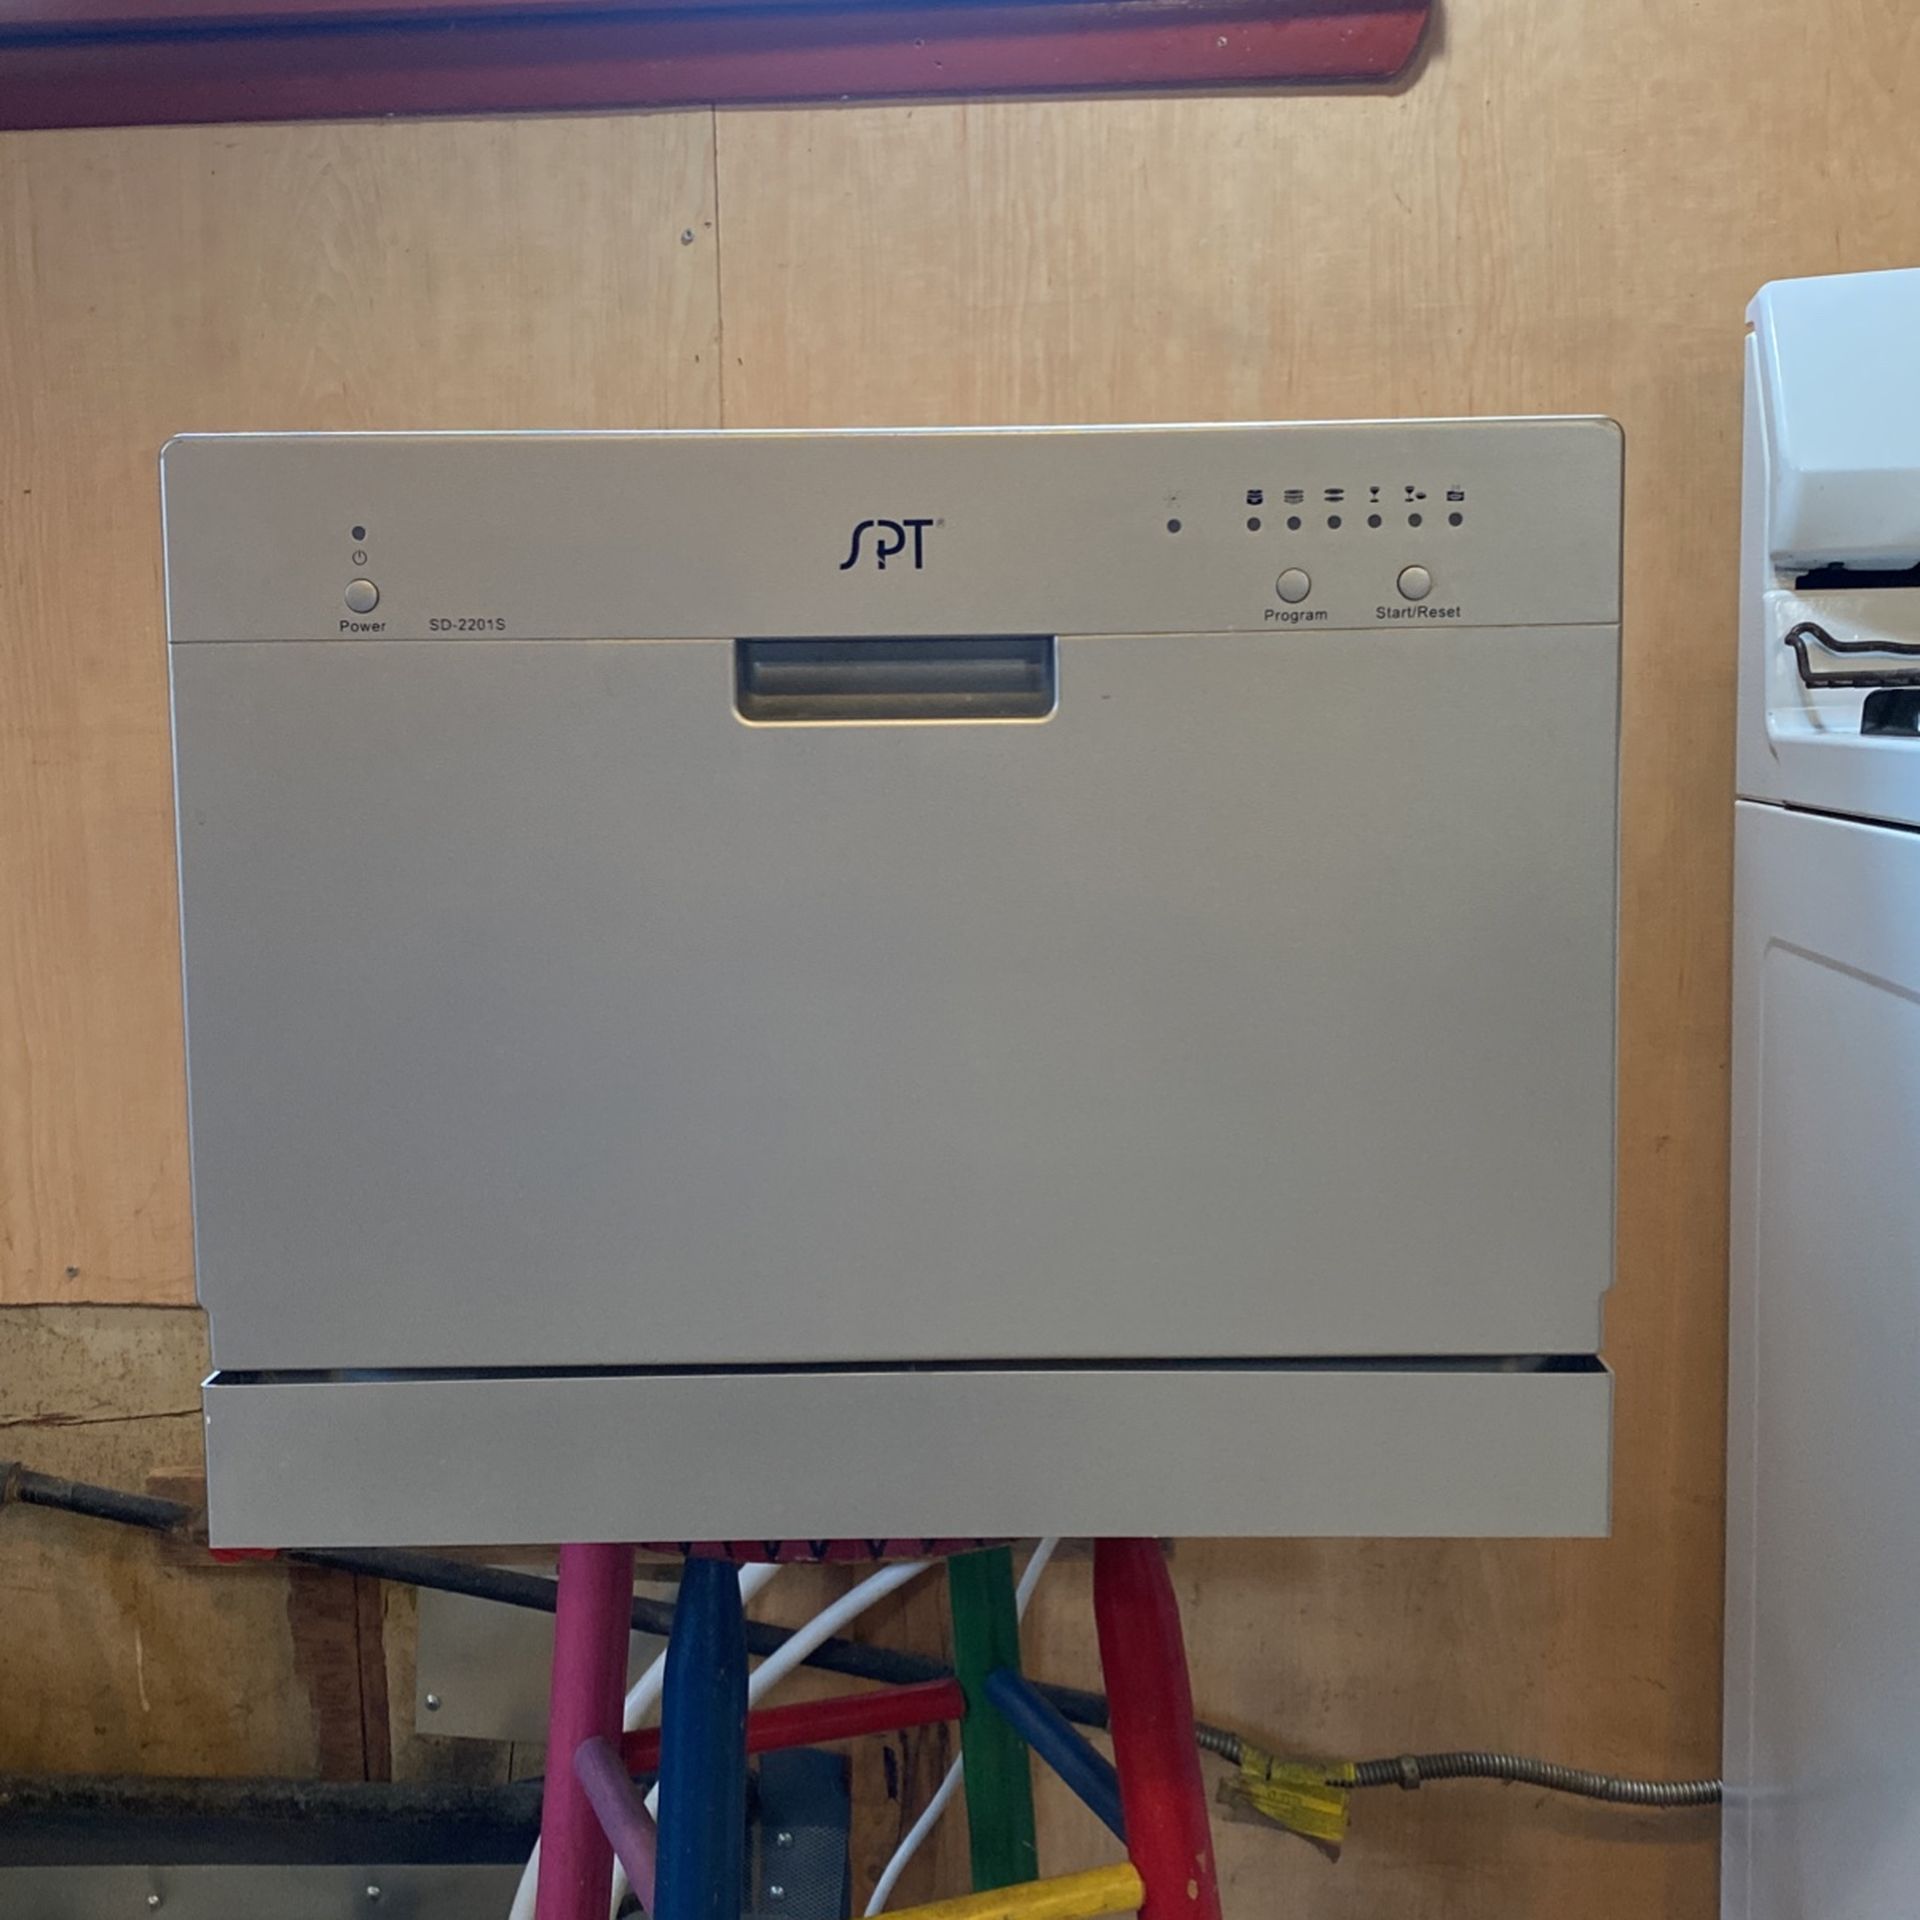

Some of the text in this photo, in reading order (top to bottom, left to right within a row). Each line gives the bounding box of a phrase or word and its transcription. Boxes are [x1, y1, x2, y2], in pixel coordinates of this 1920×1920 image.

[1264, 609, 1328, 623] Program
[1375, 606, 1461, 619] Start/Reset
[340, 620, 386, 633] Power
[429, 618, 506, 631] SD-2201S
